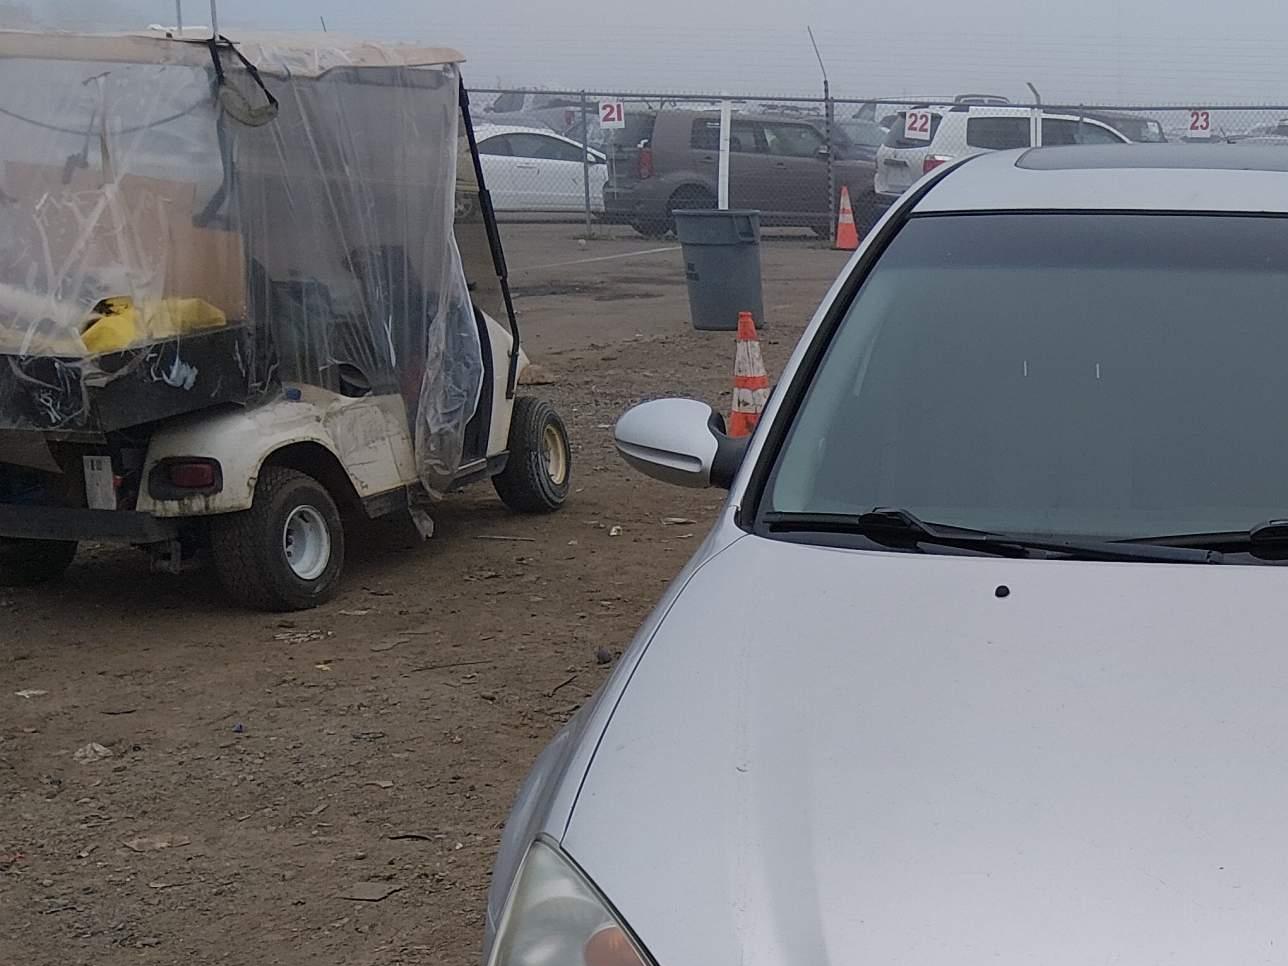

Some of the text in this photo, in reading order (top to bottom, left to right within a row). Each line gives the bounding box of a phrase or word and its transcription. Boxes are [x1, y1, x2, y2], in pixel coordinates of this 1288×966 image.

[601, 103, 623, 122] 21
[906, 112, 930, 132] 22
[1189, 111, 1211, 131] 23
